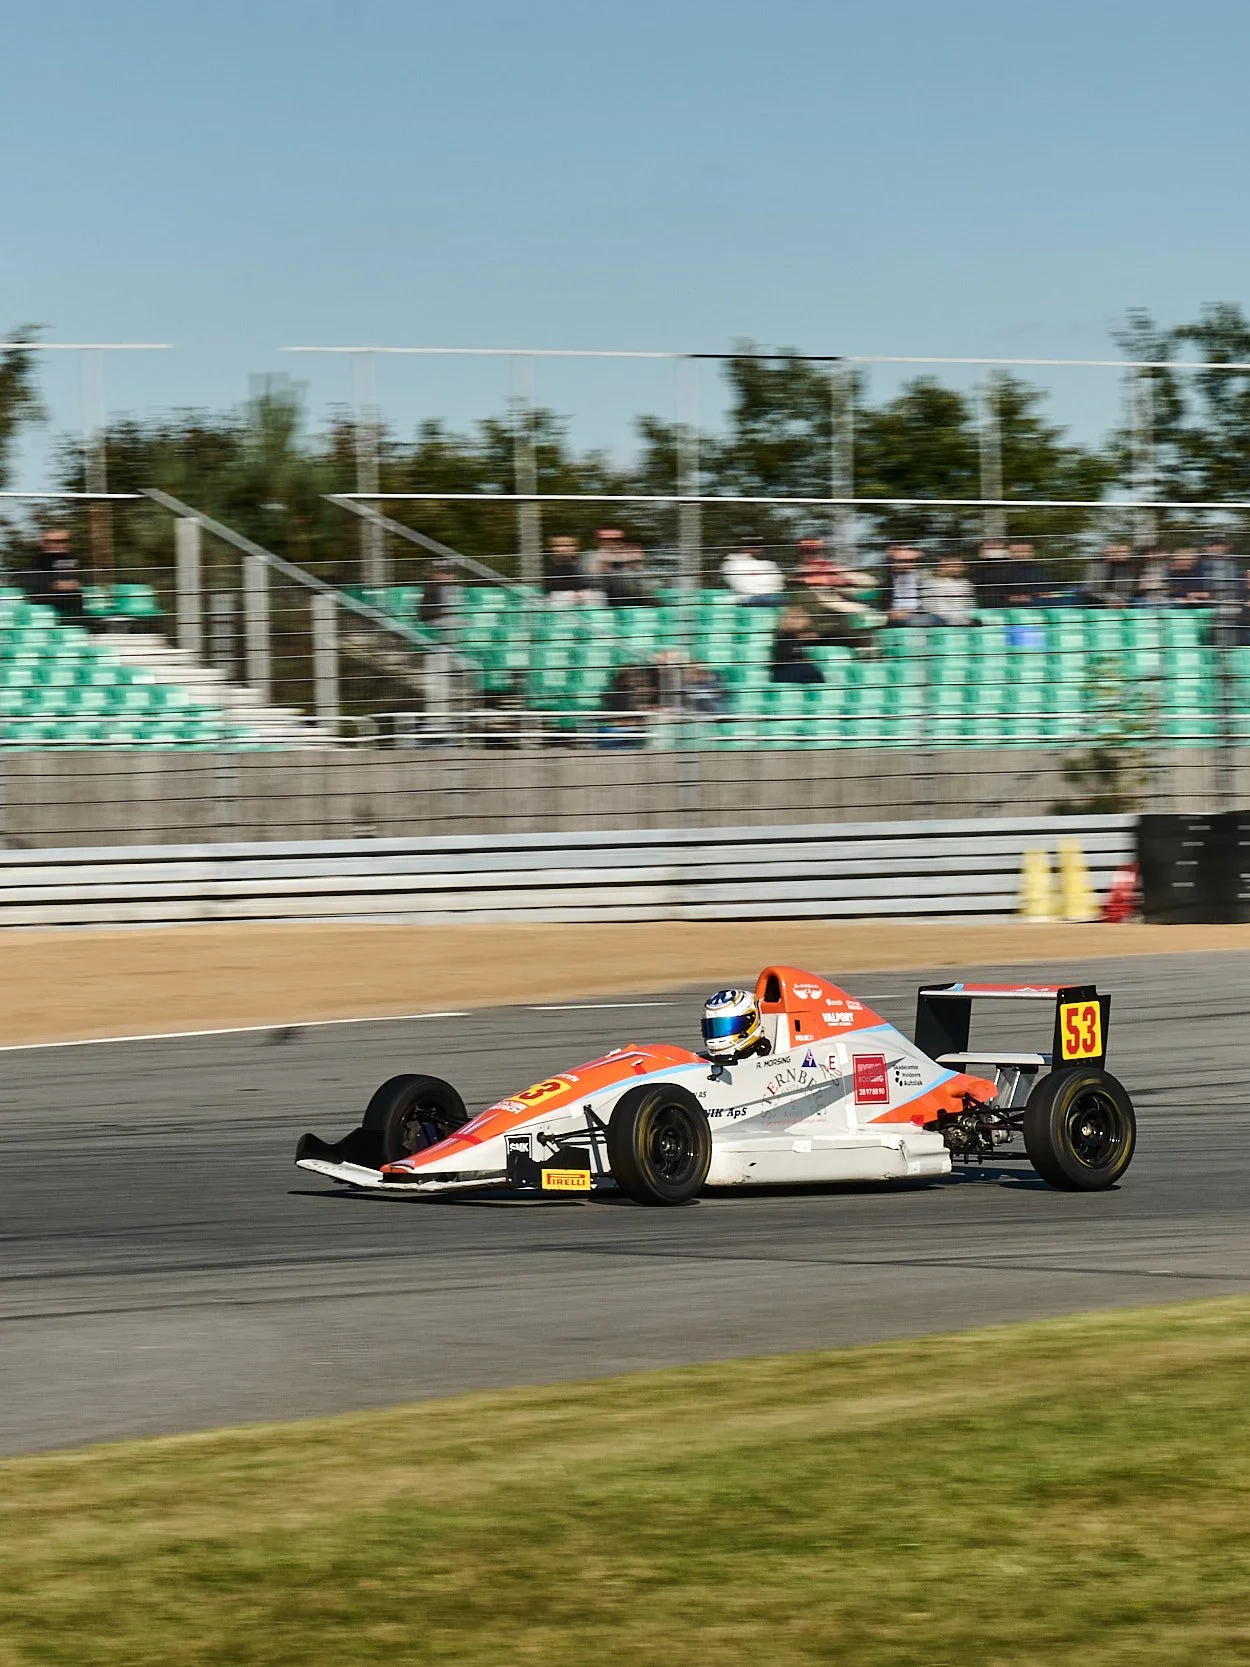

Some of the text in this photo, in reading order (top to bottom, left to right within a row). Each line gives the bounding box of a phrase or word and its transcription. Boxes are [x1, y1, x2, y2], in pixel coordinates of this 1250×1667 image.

[1066, 1006, 1096, 1054] 53
[764, 1056, 791, 1067] MORSING
[727, 1107, 748, 1119] ApS
[547, 1173, 585, 1185] PIRELLI
